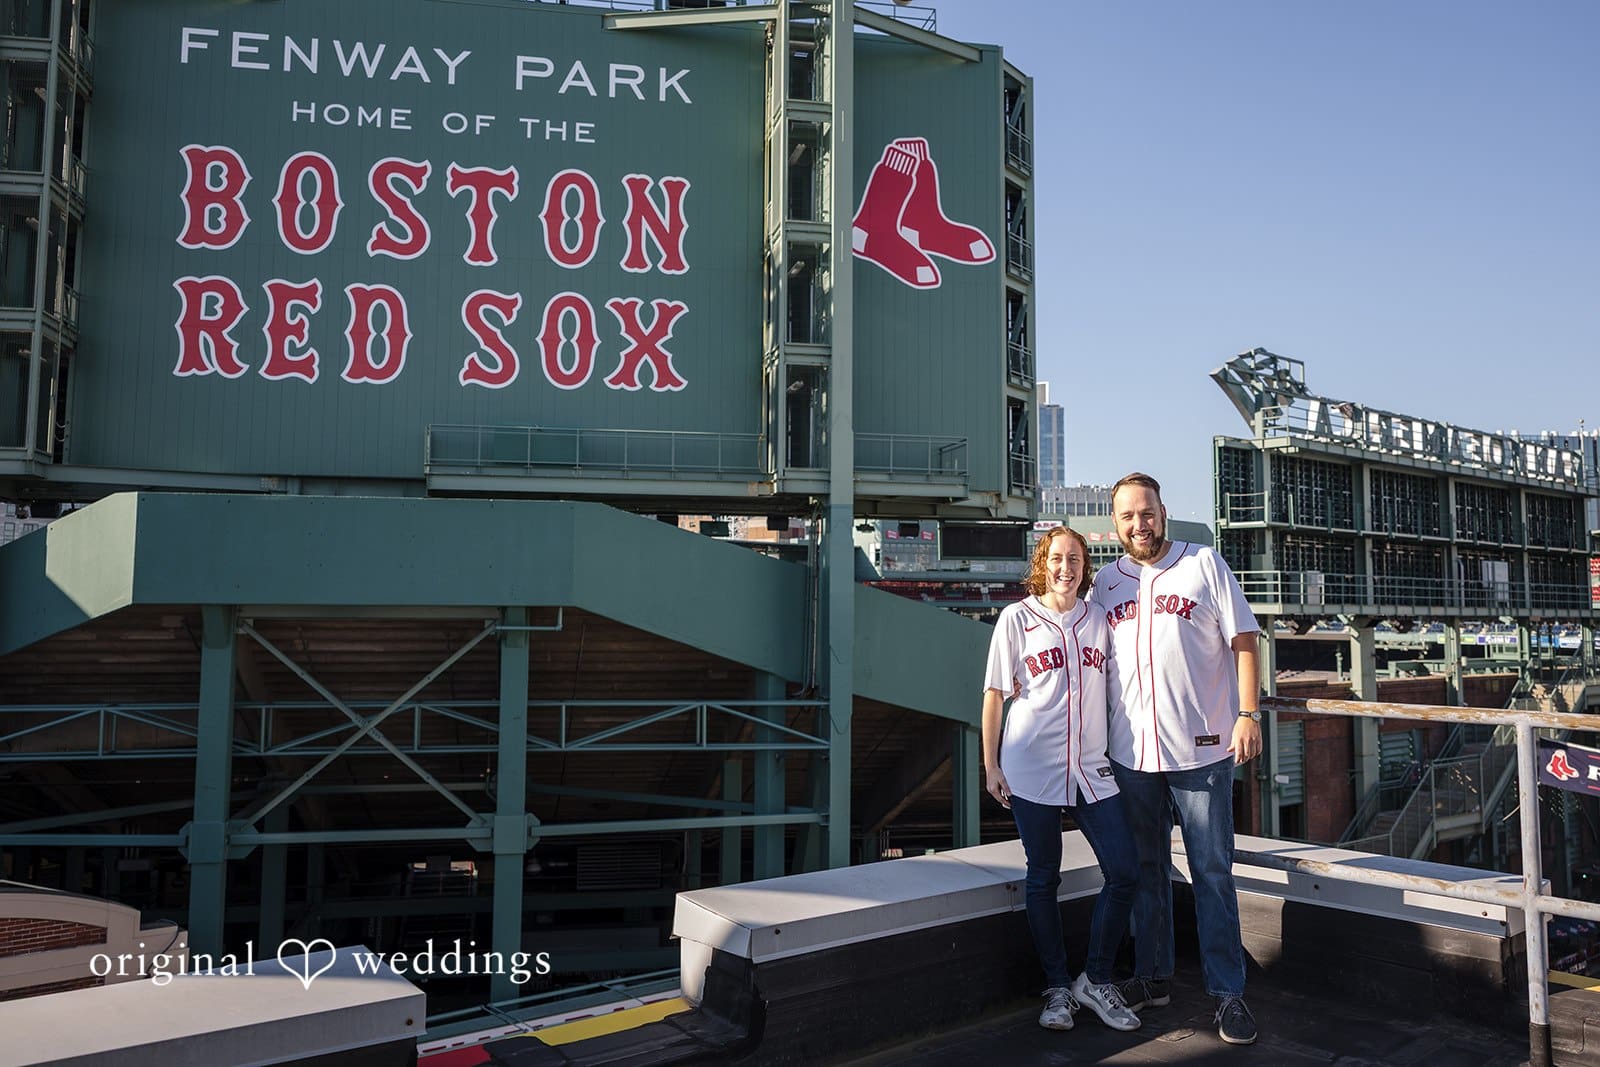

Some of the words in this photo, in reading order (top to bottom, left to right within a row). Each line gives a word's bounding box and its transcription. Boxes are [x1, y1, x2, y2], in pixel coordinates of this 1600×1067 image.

[180, 27, 472, 85] FENWAY
[515, 55, 693, 105] PARK
[292, 100, 412, 130] HOME
[442, 112, 496, 136] OF
[519, 117, 597, 144] THE
[175, 143, 692, 276] BOSTON
[171, 274, 414, 386] RED
[458, 288, 690, 393] SOX
[1106, 600, 1137, 630] RED
[1154, 594, 1199, 620] SOX
[1025, 646, 1065, 678] RED
